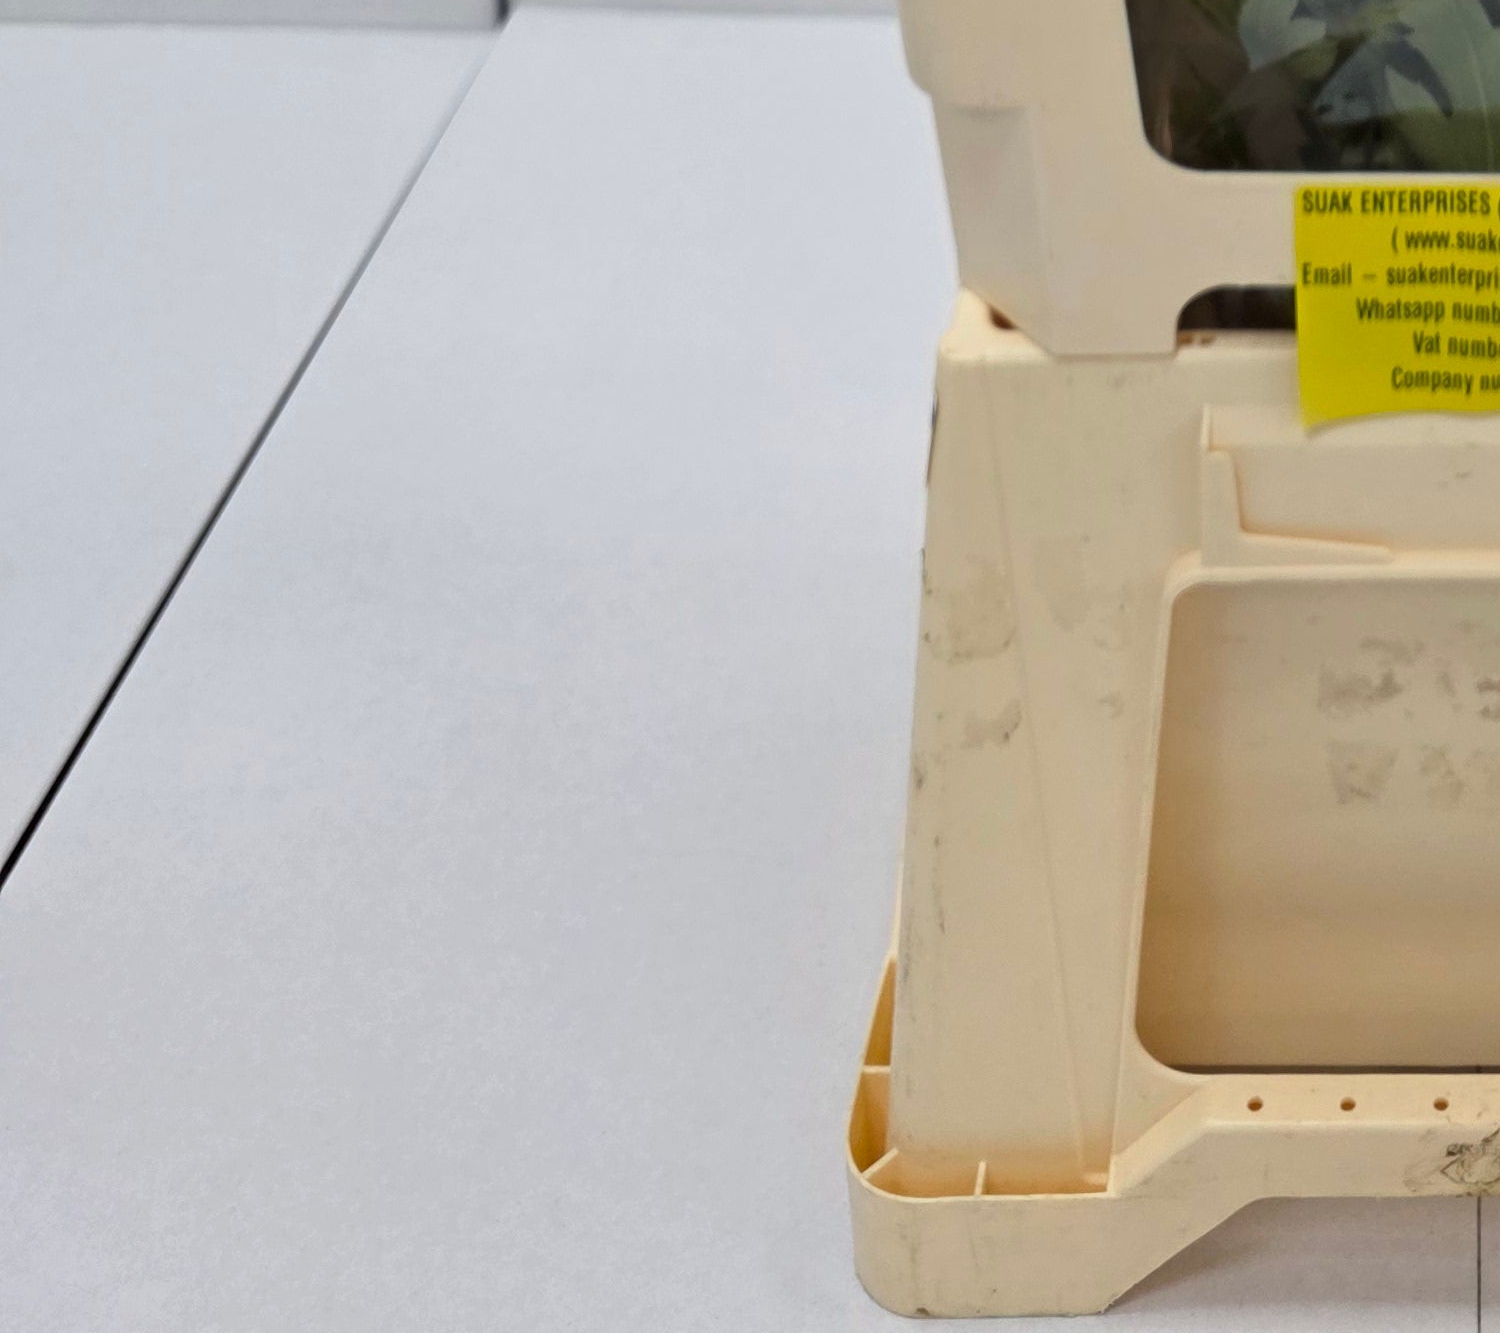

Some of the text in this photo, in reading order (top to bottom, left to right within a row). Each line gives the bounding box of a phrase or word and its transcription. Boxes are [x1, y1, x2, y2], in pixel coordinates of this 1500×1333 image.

[1302, 189, 1353, 215] SUAK
[1360, 189, 1491, 216] ENTERPRISES
[1302, 261, 1353, 288] Email
[1355, 297, 1446, 324] Whatsapp
[1412, 330, 1441, 356] Vat
[1390, 364, 1473, 397] Company
